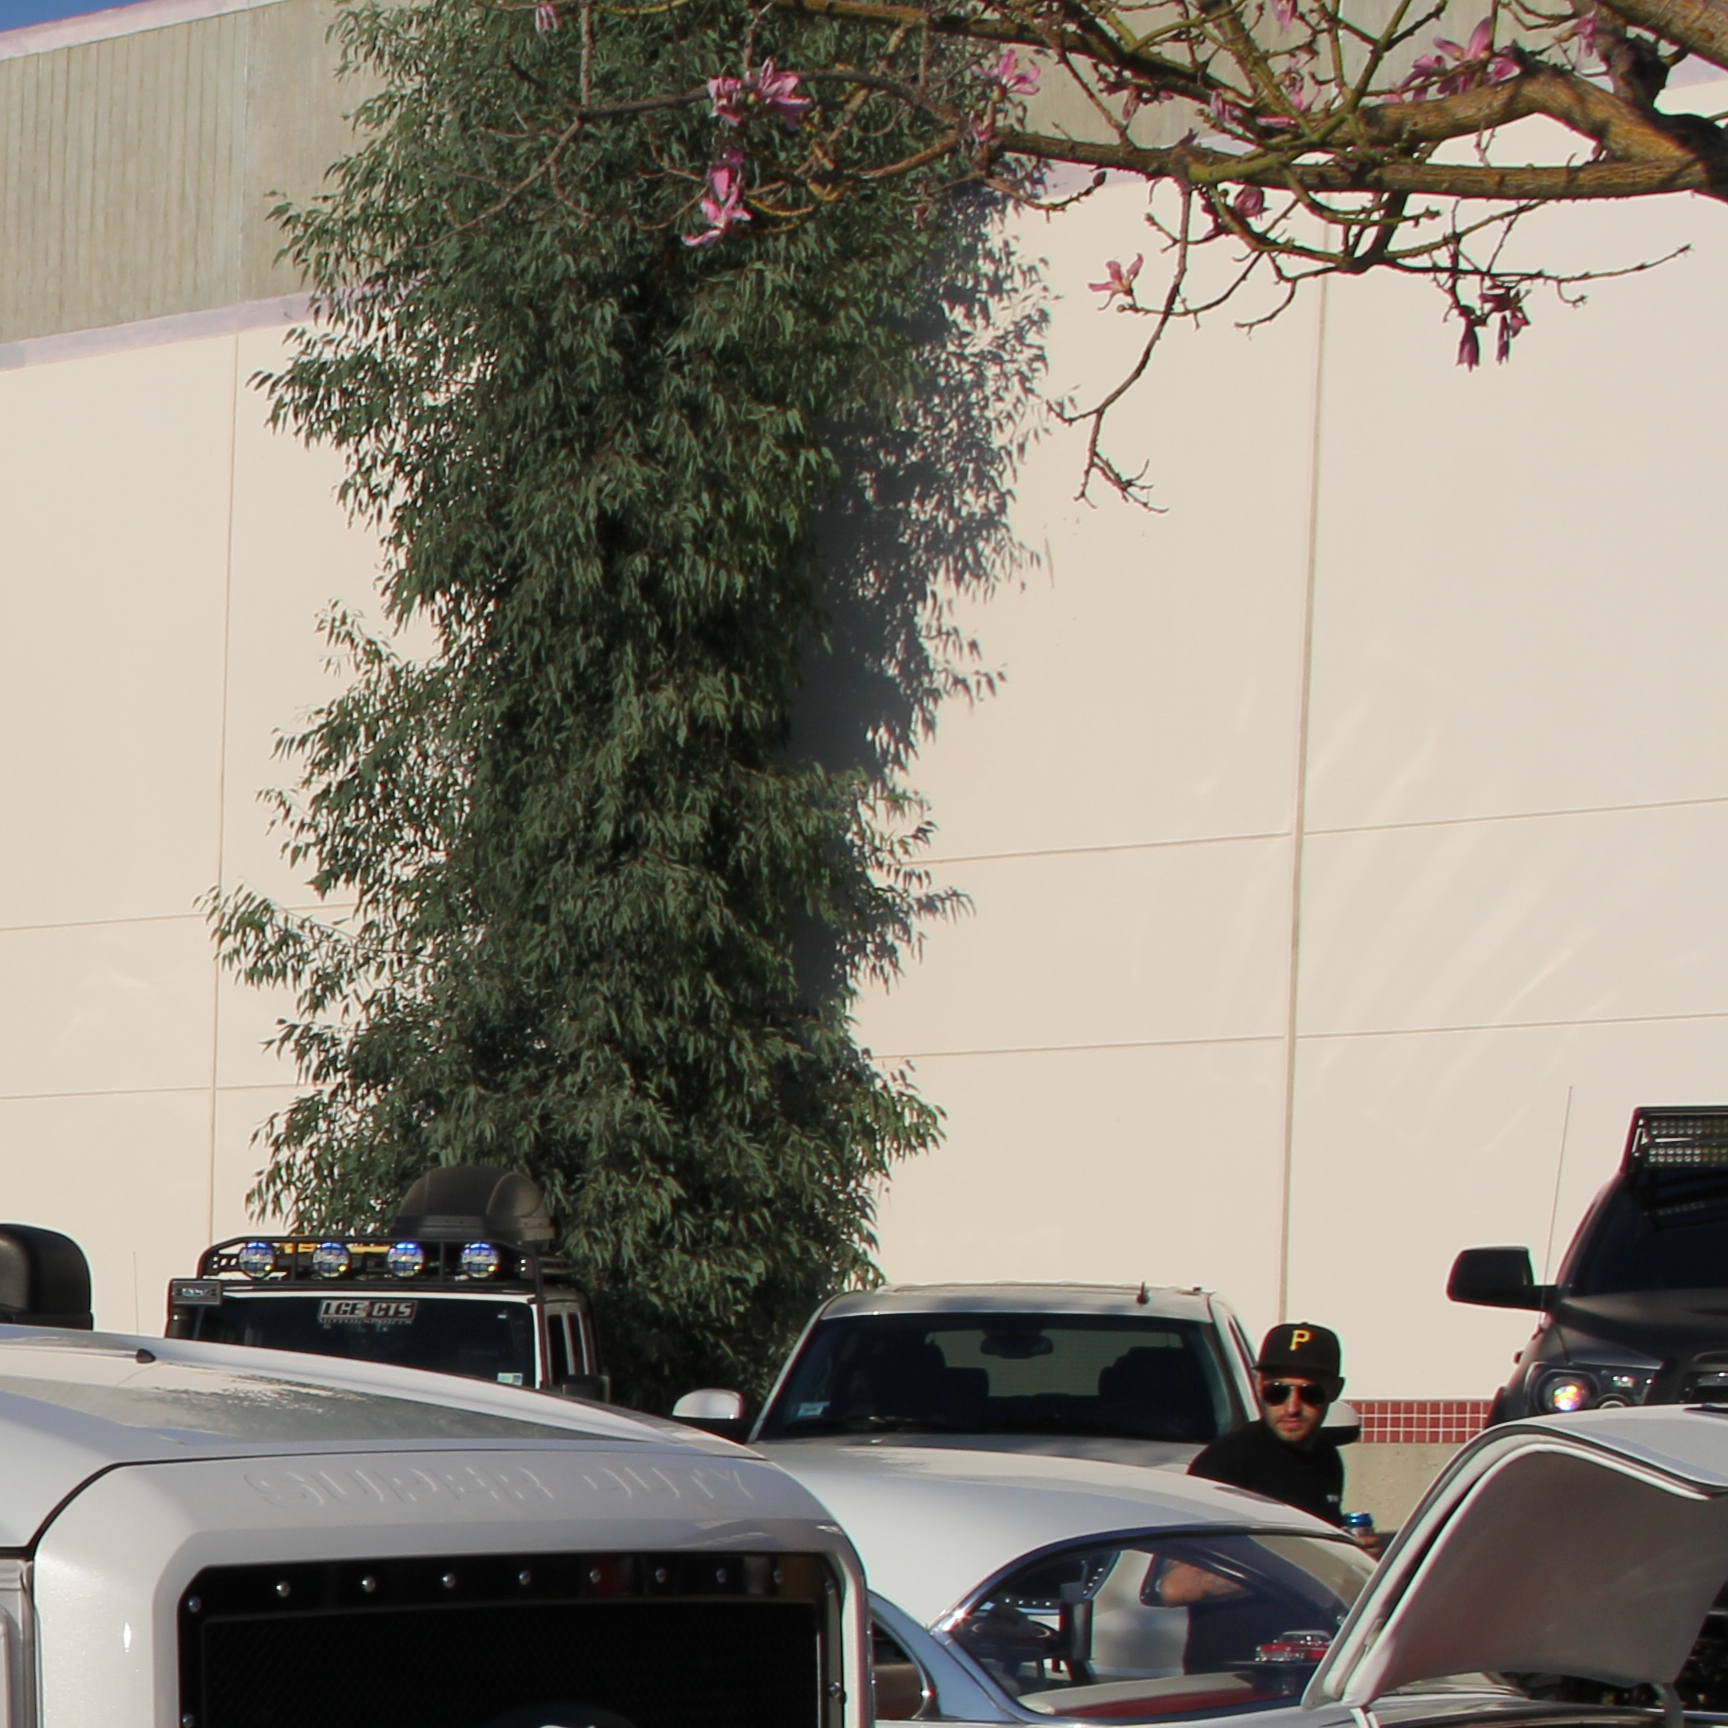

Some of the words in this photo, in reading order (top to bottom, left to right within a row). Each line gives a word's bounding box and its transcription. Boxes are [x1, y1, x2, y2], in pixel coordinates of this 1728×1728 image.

[371, 1301, 413, 1317] CTS
[1290, 1329, 1313, 1351] P
[243, 1466, 555, 1507] SUPER
[574, 1466, 754, 1500] DUTY
